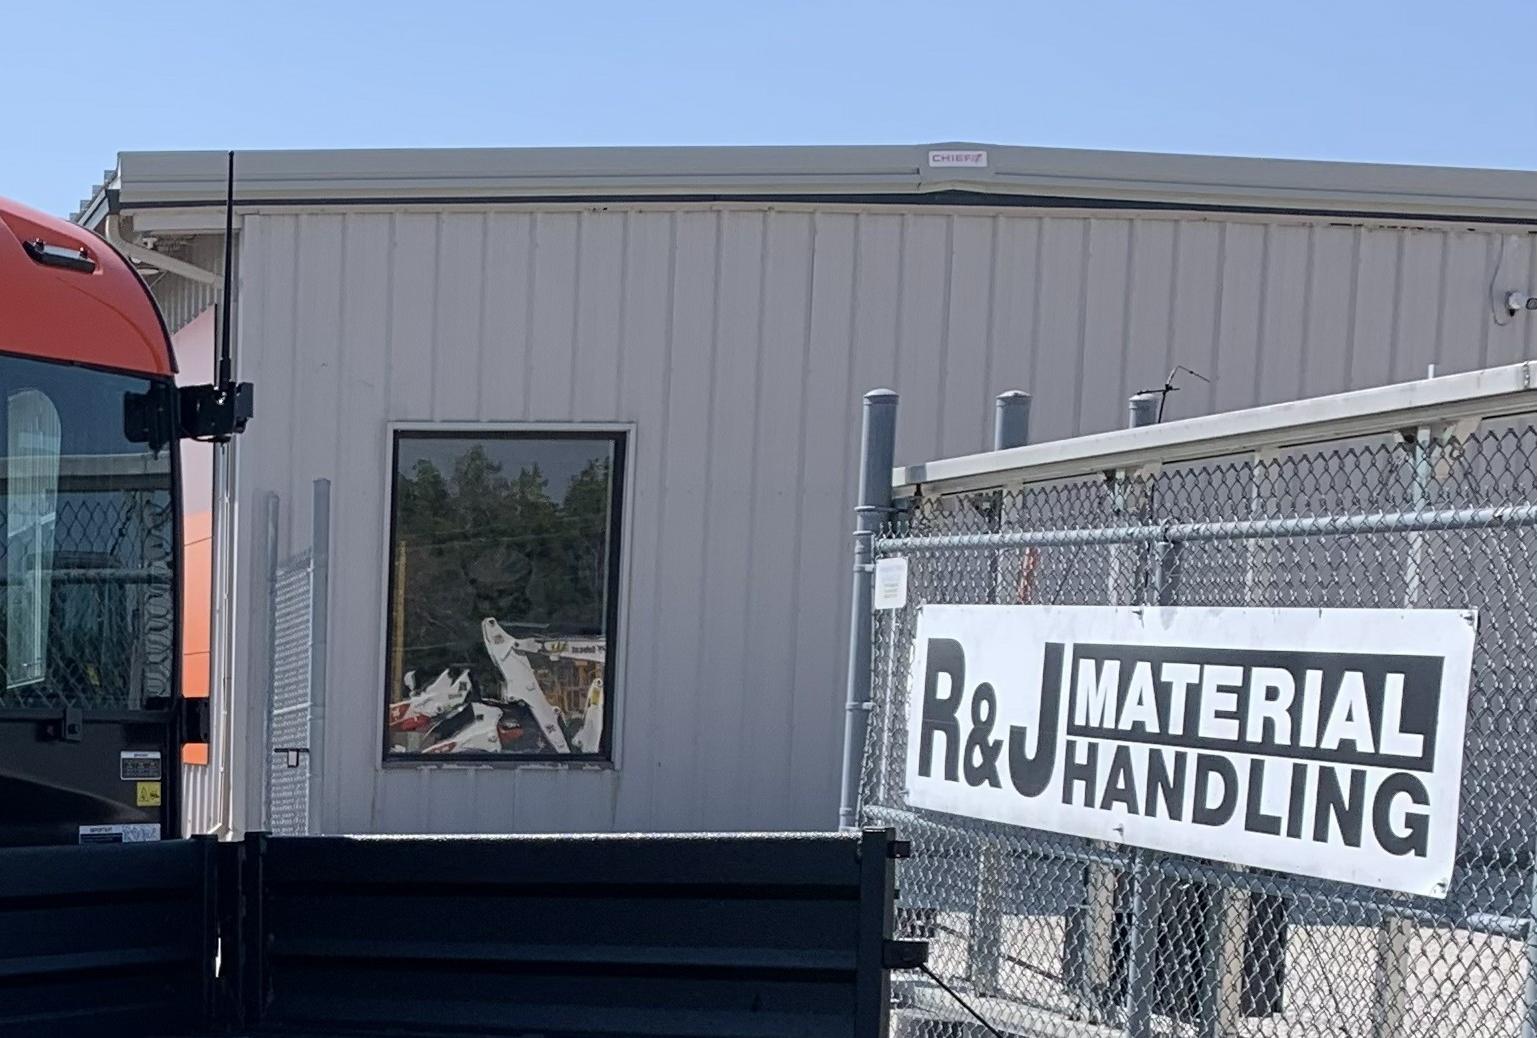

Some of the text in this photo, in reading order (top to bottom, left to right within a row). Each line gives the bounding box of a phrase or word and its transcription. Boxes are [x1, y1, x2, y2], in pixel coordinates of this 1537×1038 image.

[932, 153, 972, 162] CHIEF
[918, 637, 1065, 798] R&J
[1073, 657, 1426, 759] MATERIAL
[1061, 738, 1432, 858] HANDLING
